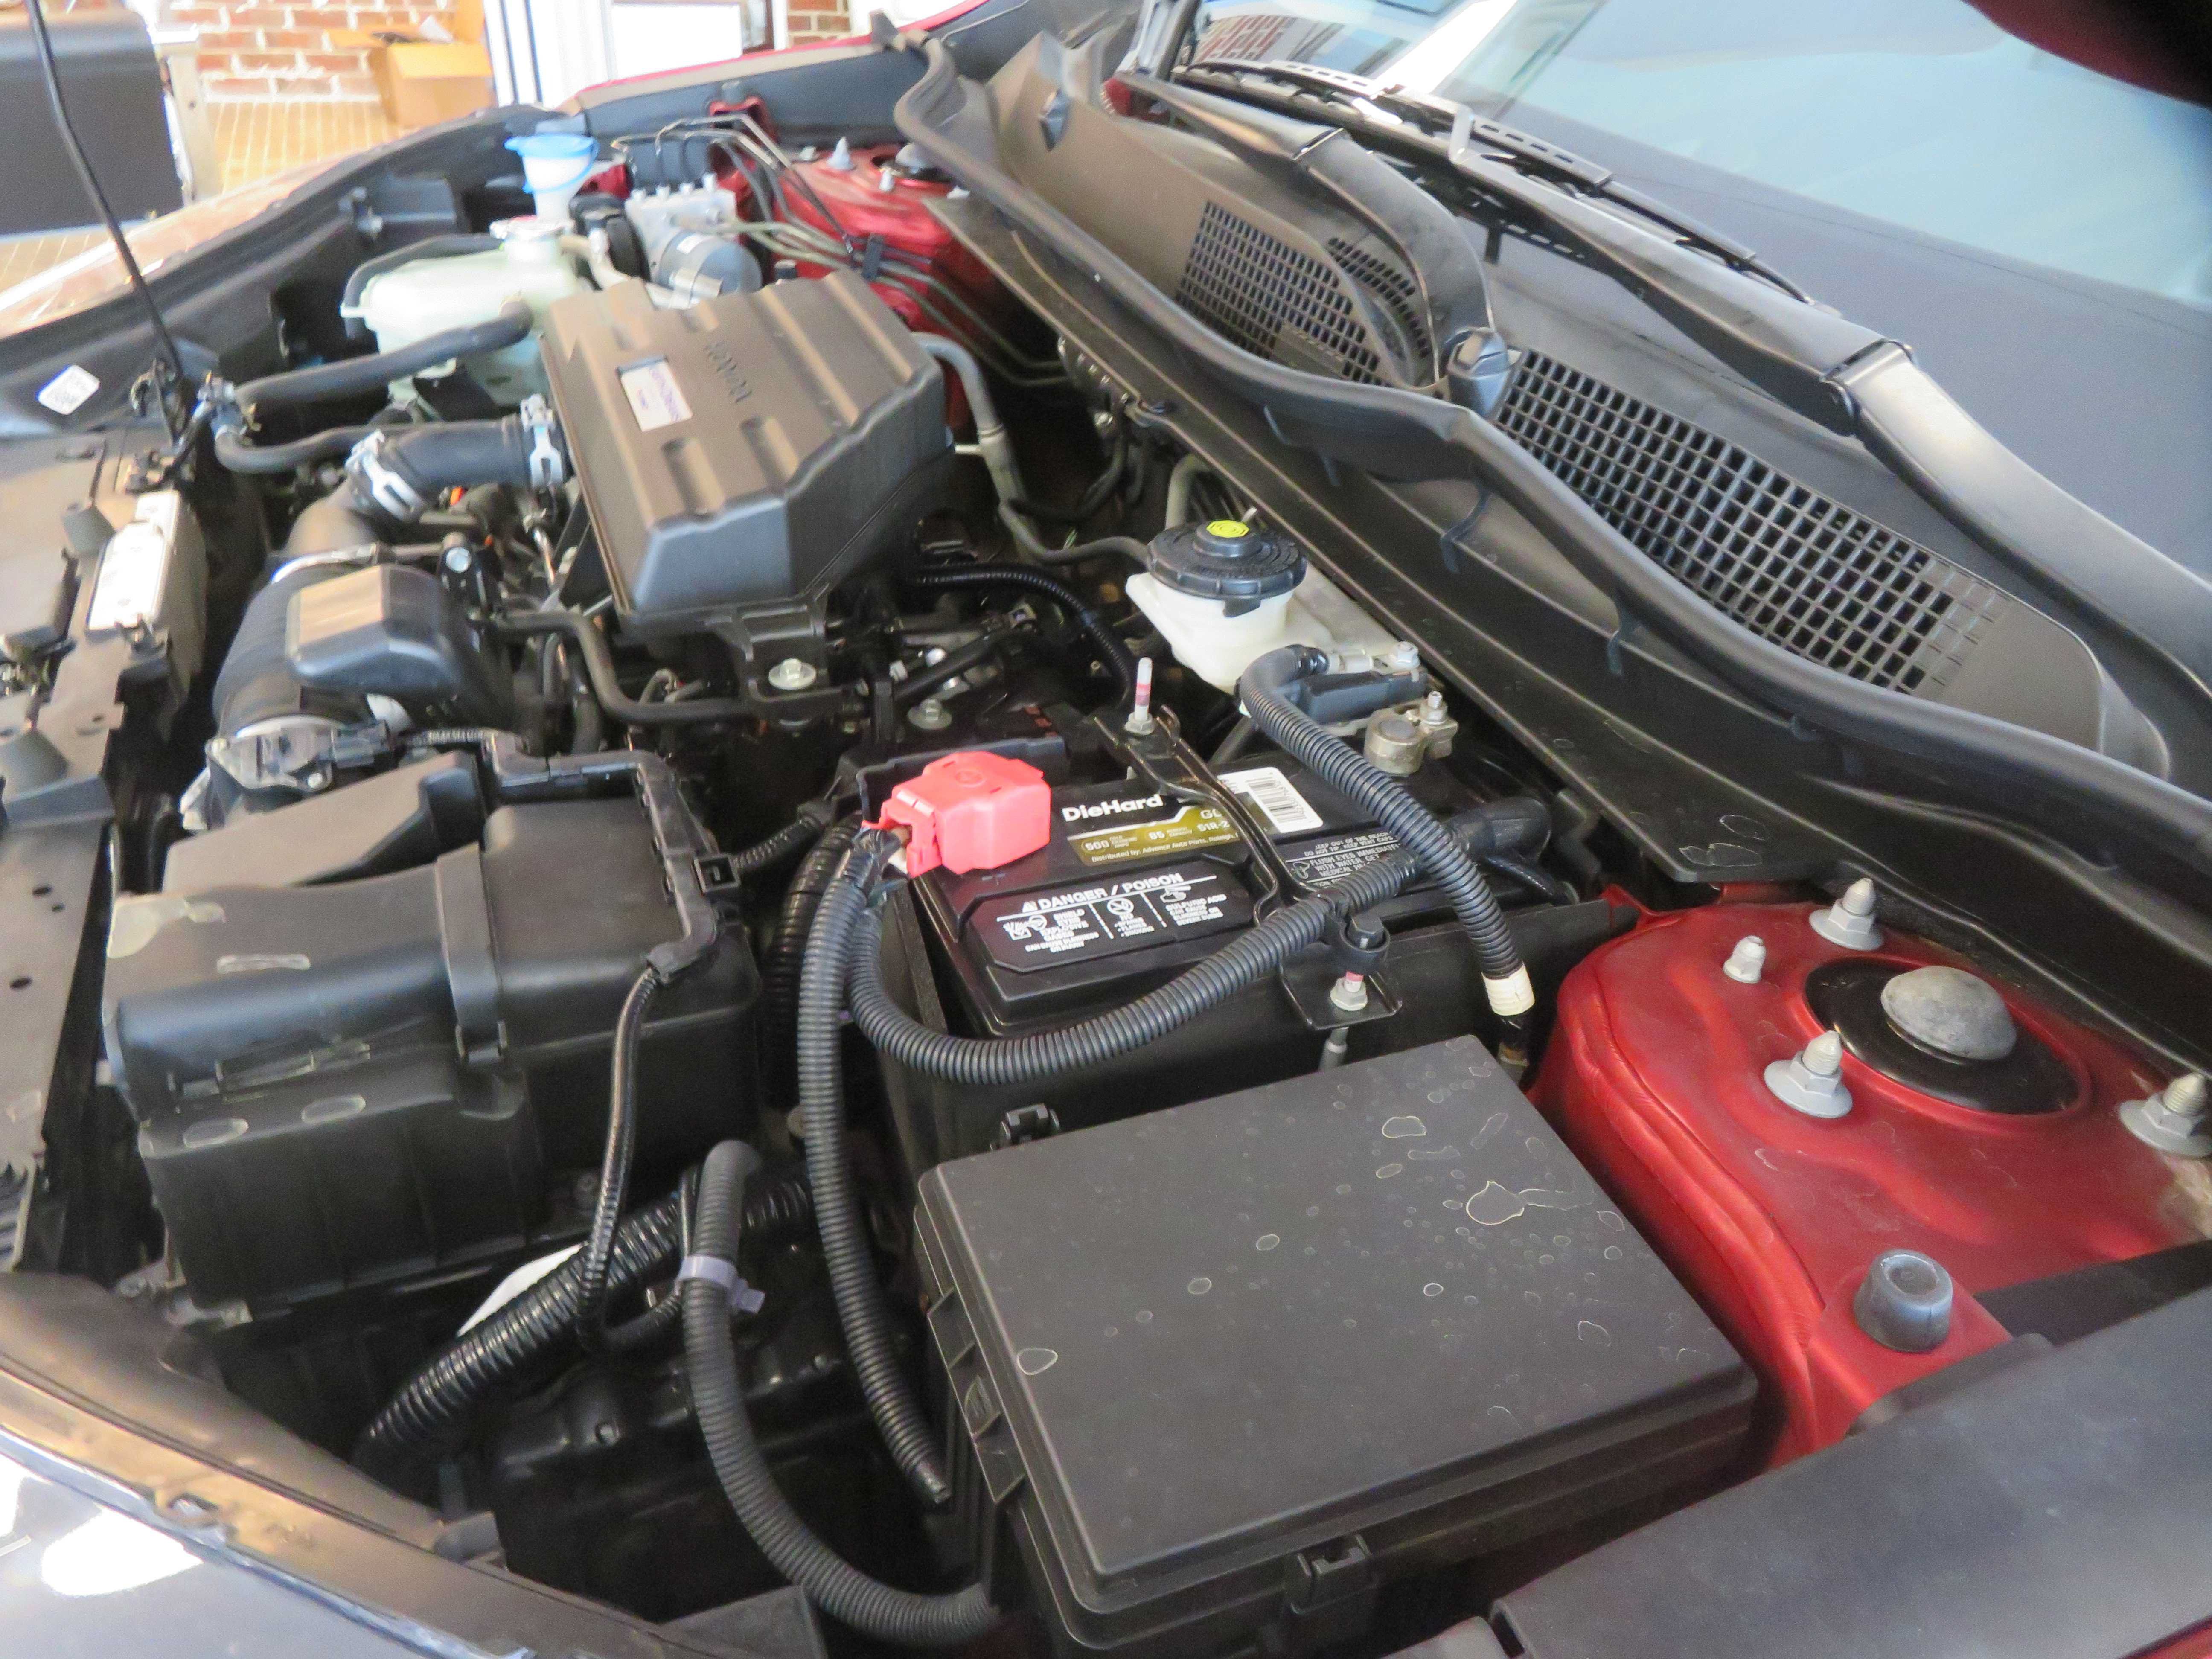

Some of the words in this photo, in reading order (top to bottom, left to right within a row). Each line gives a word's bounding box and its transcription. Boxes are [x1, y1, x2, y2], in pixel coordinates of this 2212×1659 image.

[1061, 794, 1164, 822] DieHard
[1085, 839, 1110, 852] 500
[1091, 850, 1129, 862] Distributed
[1142, 842, 1171, 853] Advance
[1314, 864, 1336, 872] WITH
[1365, 853, 1380, 862] GET
[1336, 852, 1356, 861] EYES
[1038, 887, 1108, 910] DANGER
[1122, 873, 1184, 893] POISON
